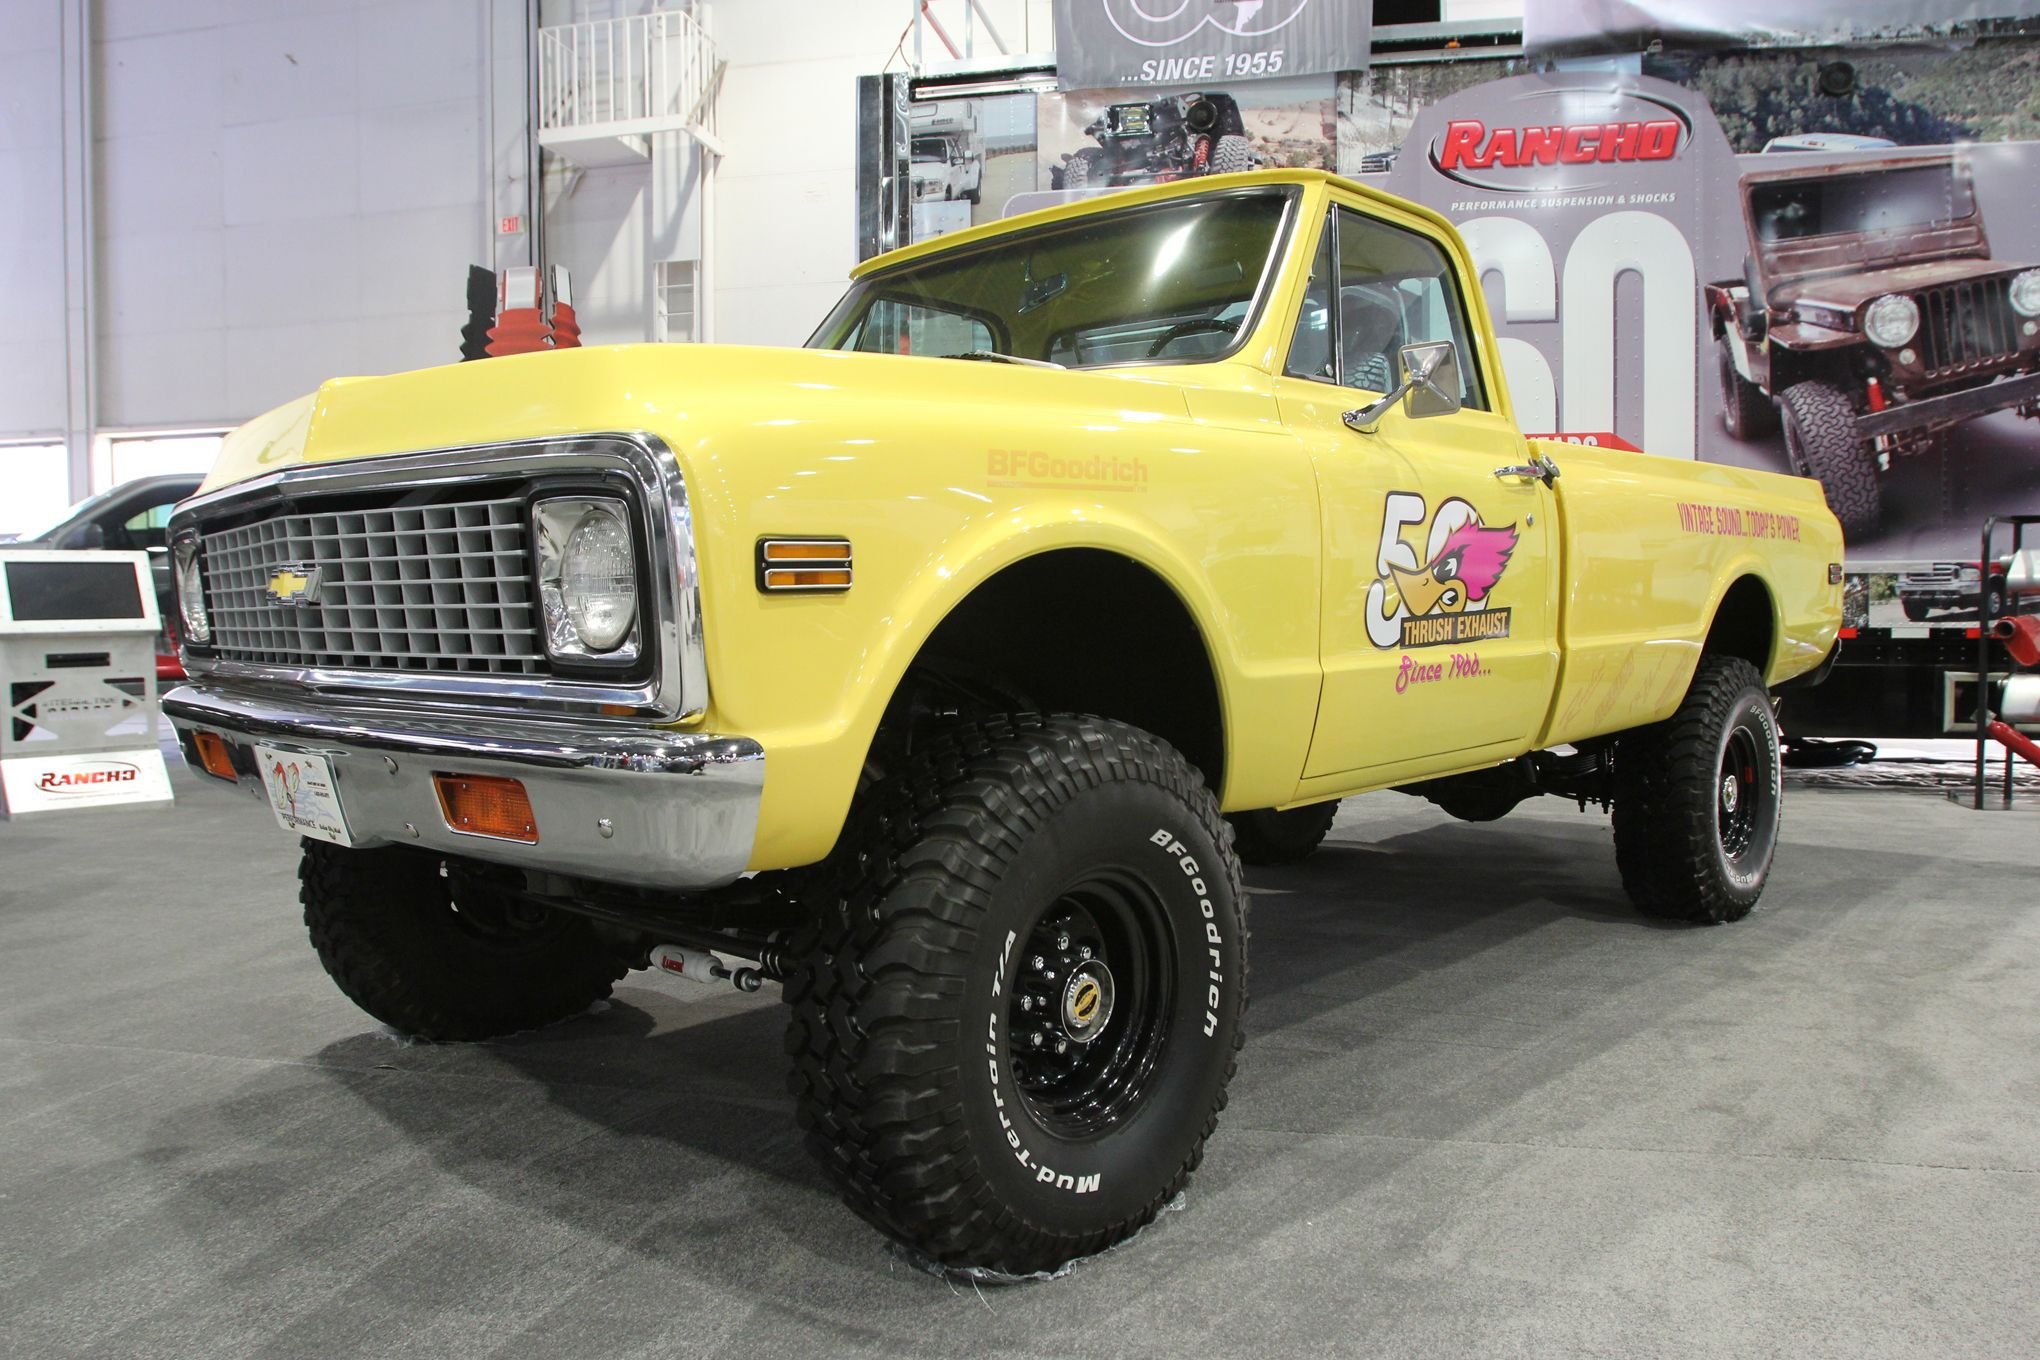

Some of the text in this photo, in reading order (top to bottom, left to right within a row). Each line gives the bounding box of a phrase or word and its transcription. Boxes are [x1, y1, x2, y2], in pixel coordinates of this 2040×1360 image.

[1225, 51, 1284, 76] 1955
[1440, 120, 1681, 170] RANCHO
[1450, 192, 1676, 212] PERFORMANCE SUSPENSION & SHOCKS
[502, 217, 519, 232] EXIT
[987, 448, 1148, 483] BFGoodrich
[1677, 502, 1715, 535] VINTAGE
[1403, 612, 1507, 645] THRUSH EXHAUST
[1395, 655, 1443, 695] Since
[1750, 704, 1779, 796] BFGoodrich
[1150, 828, 1224, 1038] BFGoodrich
[986, 929, 1101, 1194] Mud-Terrain T/A
